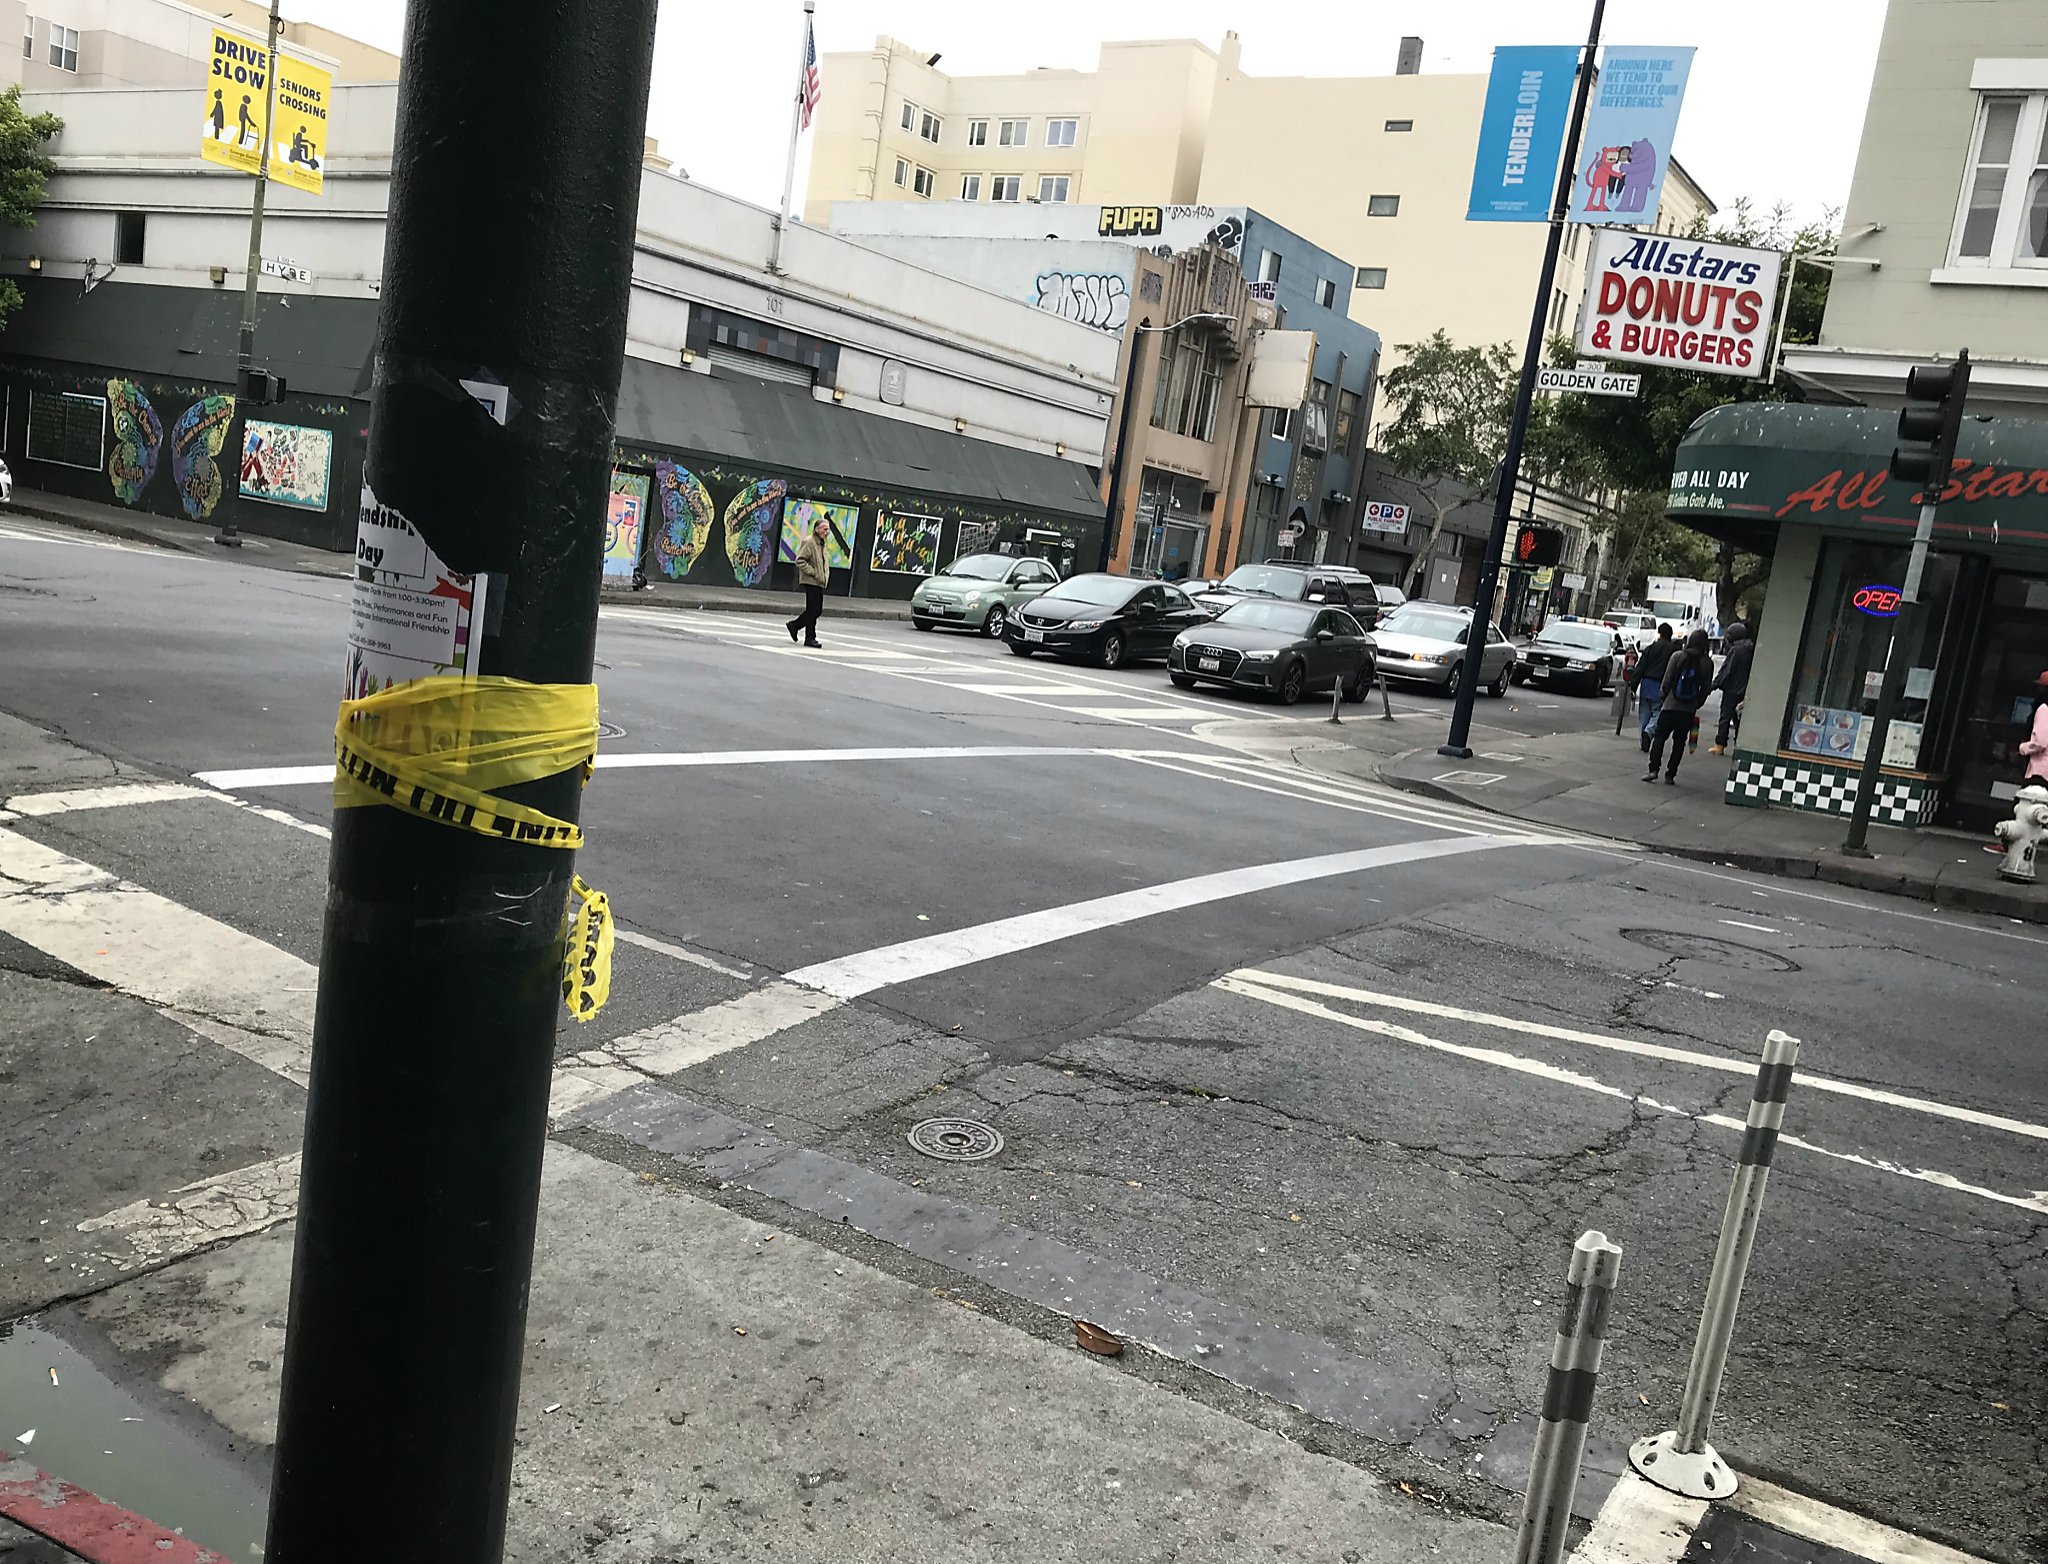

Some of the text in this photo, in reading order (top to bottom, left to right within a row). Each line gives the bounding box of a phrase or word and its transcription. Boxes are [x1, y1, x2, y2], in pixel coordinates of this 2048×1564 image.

[214, 36, 266, 69] DRIVE
[212, 58, 265, 90] SLOW
[1608, 60, 1674, 71] AROUND HERE
[1605, 71, 1663, 83] WE TEND TO
[279, 78, 321, 102] SENIORS
[1602, 84, 1678, 96] CELEBRATE OUR
[279, 94, 326, 120] CROSSING
[1502, 70, 1544, 187] TENDERLOIN
[1099, 205, 1163, 236] FUPA
[266, 261, 307, 281] HYDE
[1609, 236, 1761, 285] Allstars
[766, 296, 783, 315] 101
[1597, 271, 1763, 334] DONUTS
[1591, 319, 1754, 367] & BURGERS
[1540, 372, 1637, 392] GOLDEN GATE
[1689, 470, 1711, 488] ALL
[1717, 470, 1750, 489] DAY
[1689, 492, 1706, 508] Gate
[1707, 493, 1725, 510] Ave.
[1775, 469, 1889, 518] All
[1382, 506, 1392, 517] P
[358, 537, 384, 568] Day
[373, 602, 415, 618] Performances
[415, 612, 431, 621] and
[432, 614, 448, 623] Fun
[411, 621, 450, 635] Friendship
